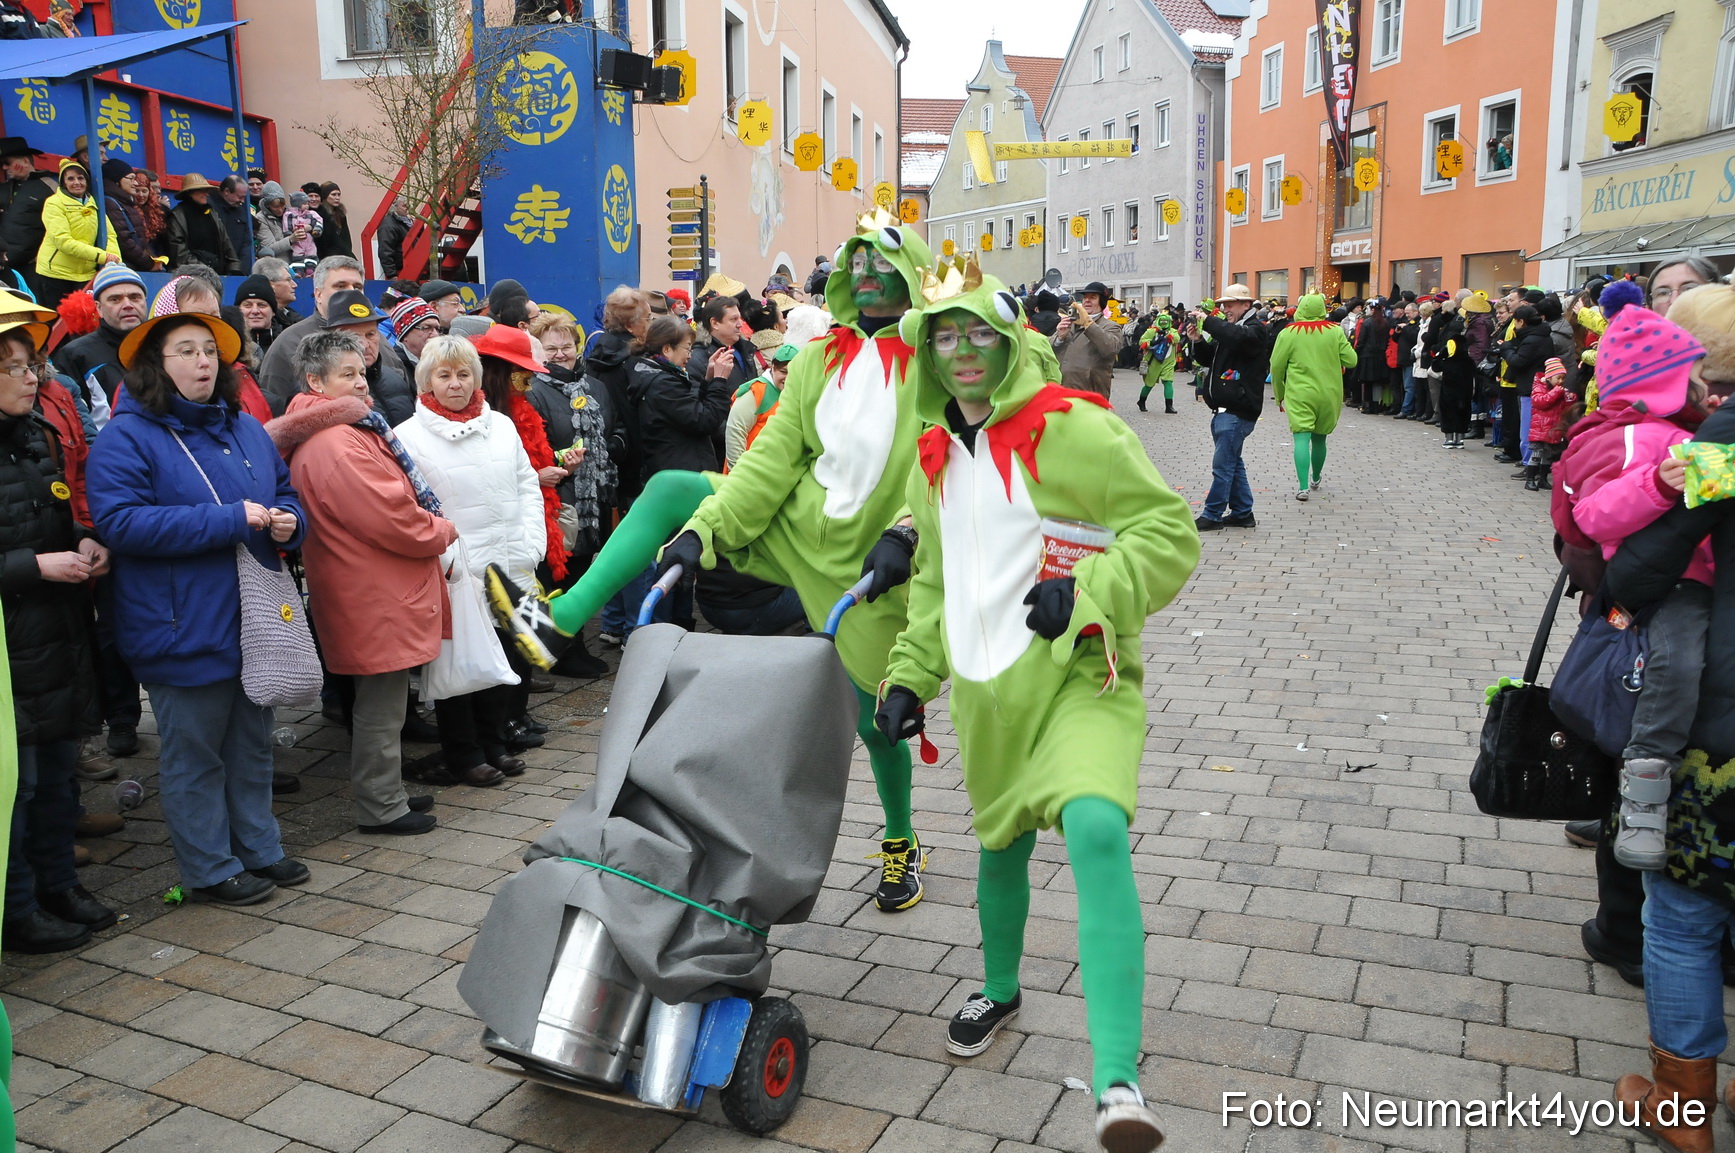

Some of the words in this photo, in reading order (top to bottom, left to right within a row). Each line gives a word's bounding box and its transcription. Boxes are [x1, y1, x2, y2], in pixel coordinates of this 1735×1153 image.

[1197, 114, 1206, 171] UHREN
[1592, 170, 1695, 214] BÄCKEREI
[1195, 179, 1205, 260] SCHMUCK
[1078, 256, 1106, 277] OPTIK
[1109, 252, 1138, 275] OEXL
[1331, 239, 1371, 257] GÖTZ
[1045, 563, 1073, 576] PARTYBE
